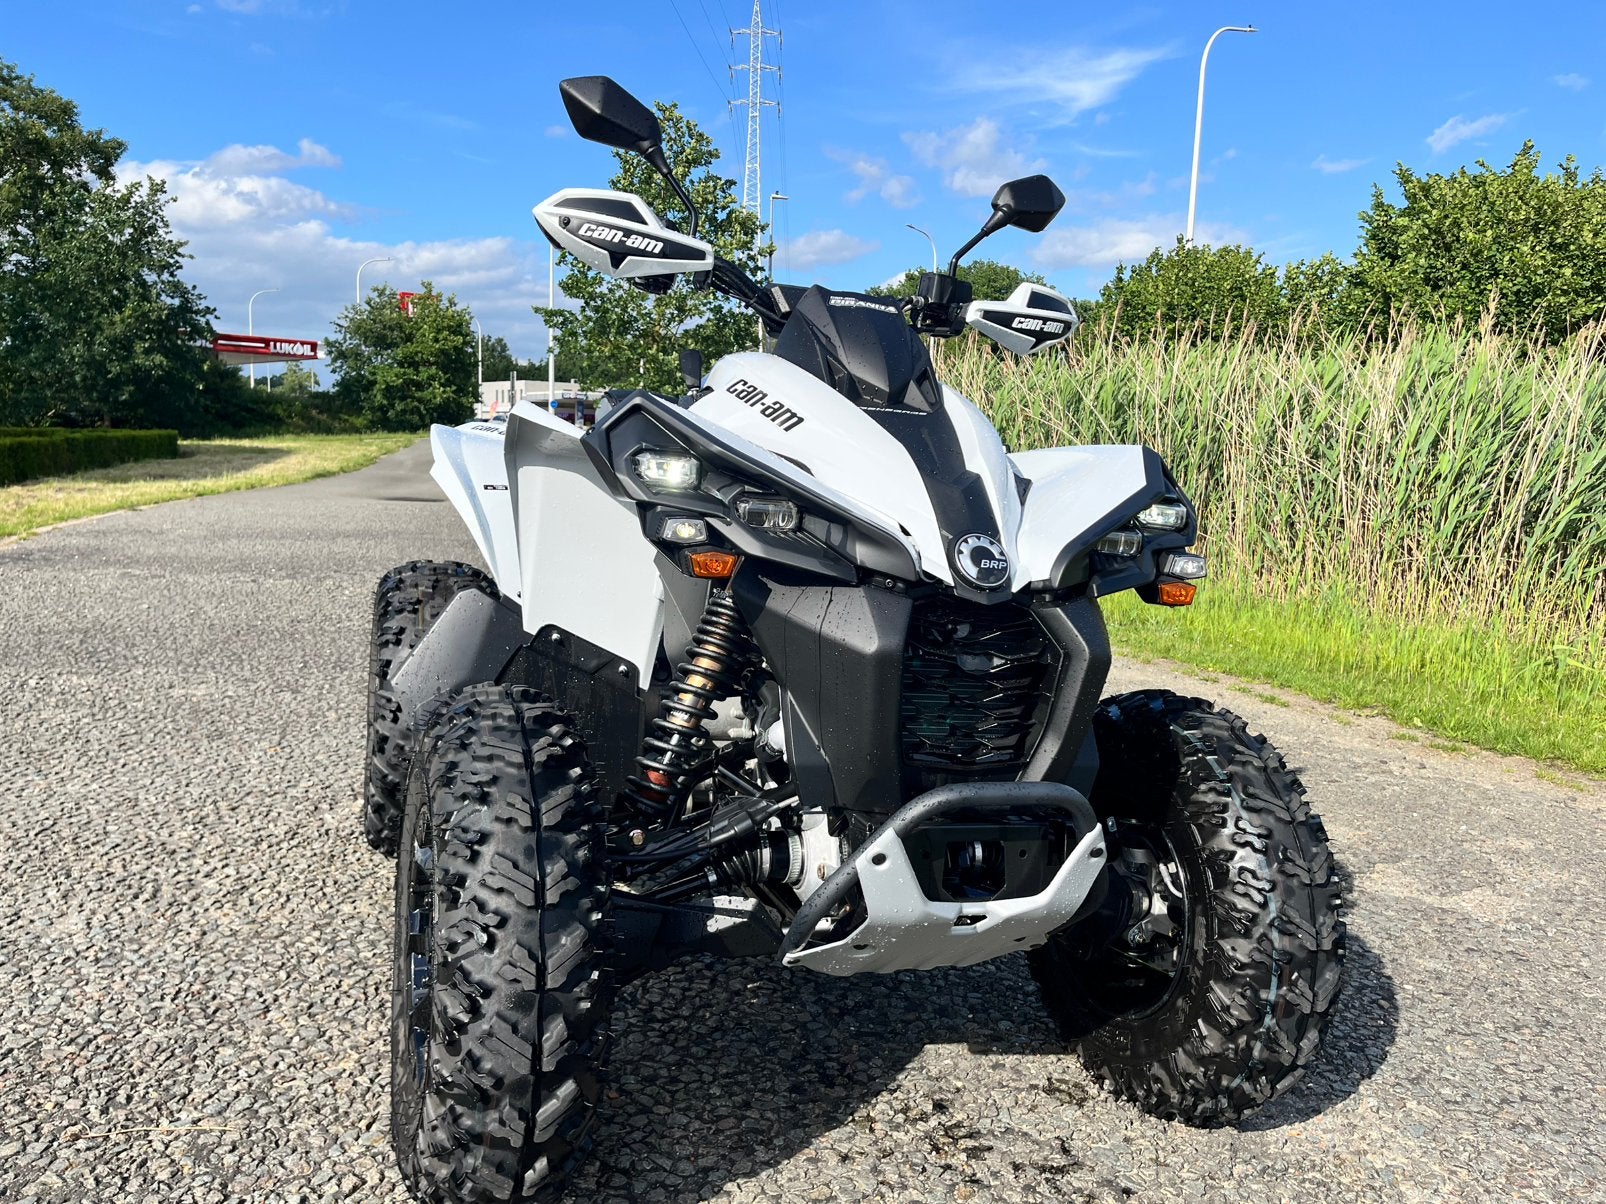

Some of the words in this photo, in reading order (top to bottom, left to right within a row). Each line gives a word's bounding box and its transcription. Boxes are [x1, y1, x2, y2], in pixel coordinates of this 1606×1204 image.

[579, 222, 664, 254] can-am
[829, 299, 898, 313] PIRANHA
[1012, 317, 1065, 333] can-am
[270, 341, 315, 356] LUKOIL
[726, 379, 805, 432] can-am
[981, 559, 1007, 570] BRP
